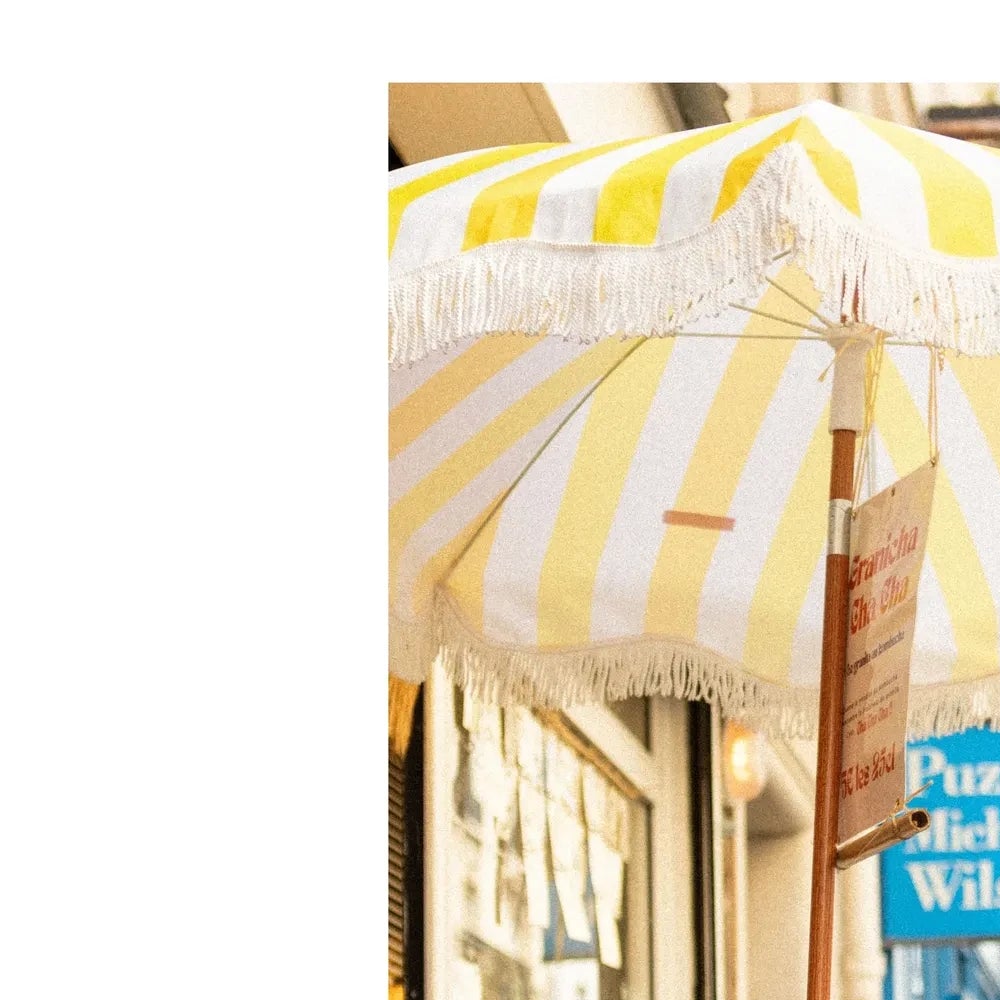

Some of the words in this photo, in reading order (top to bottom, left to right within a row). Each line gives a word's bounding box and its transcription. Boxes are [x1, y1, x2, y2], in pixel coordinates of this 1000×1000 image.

[851, 594, 876, 635] Cha
[880, 575, 909, 614] Cha
[856, 763, 870, 791] les
